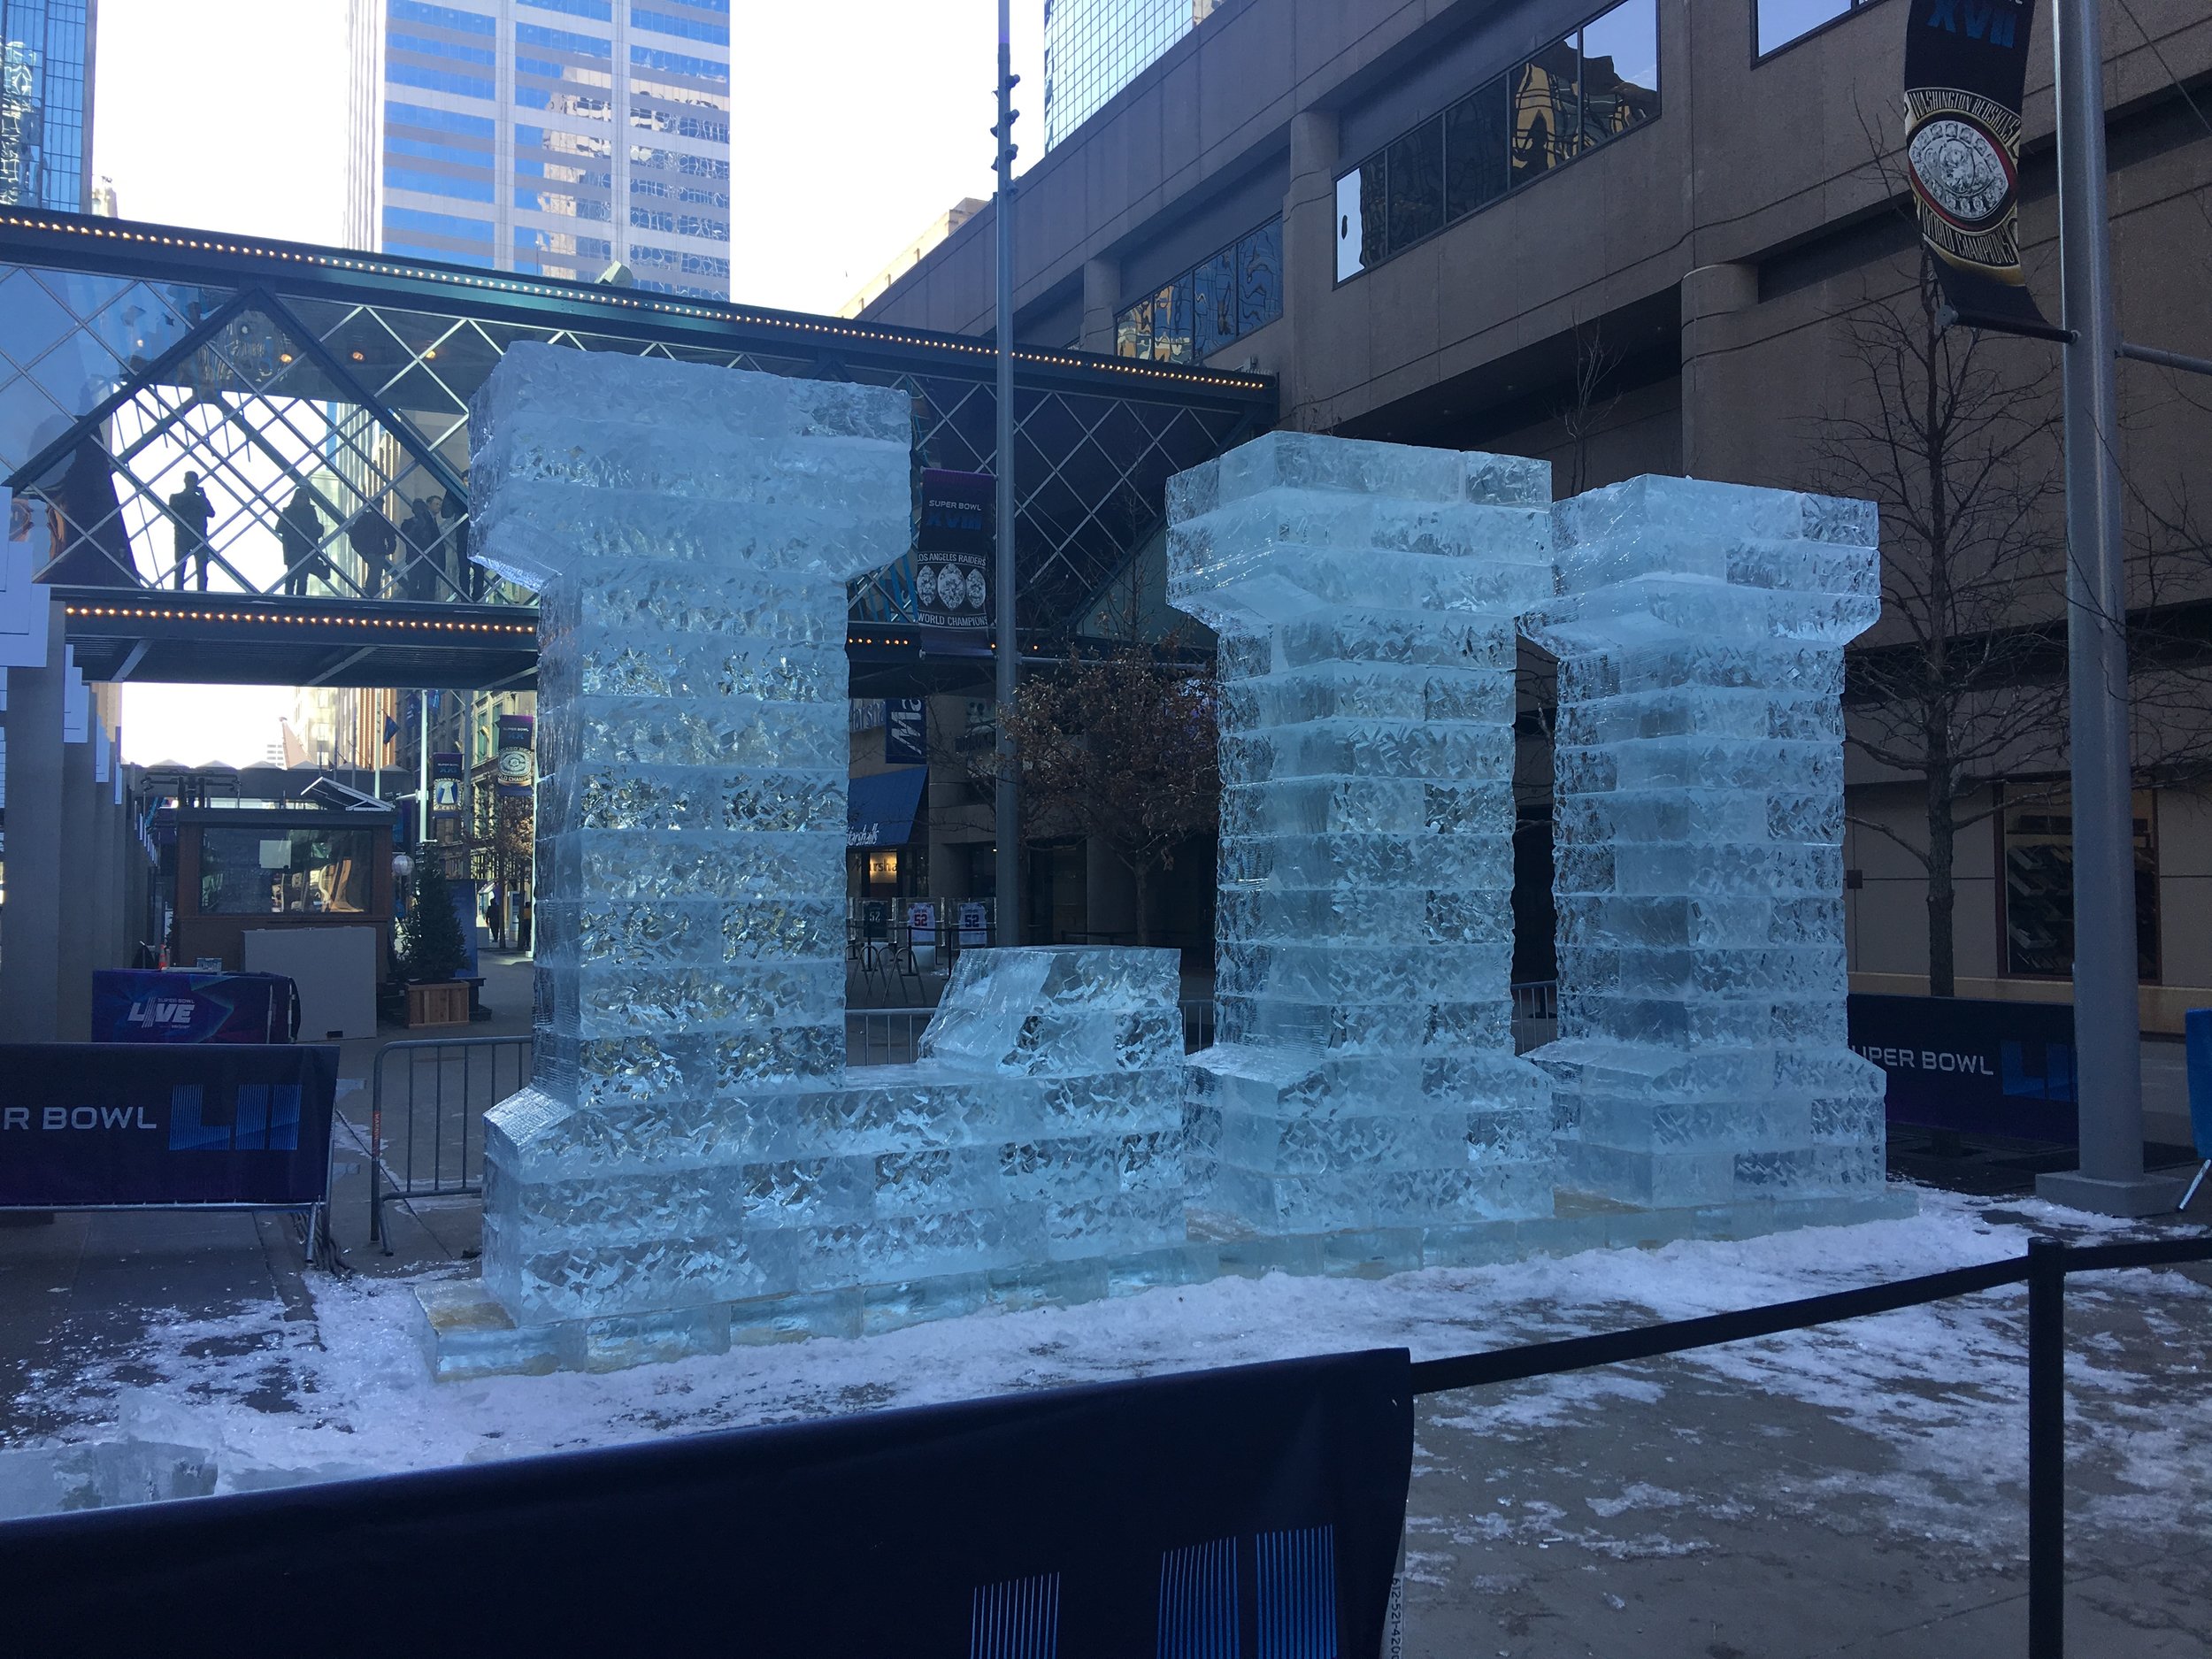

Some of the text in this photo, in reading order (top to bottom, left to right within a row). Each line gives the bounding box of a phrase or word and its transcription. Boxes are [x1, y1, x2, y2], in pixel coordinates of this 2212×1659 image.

[1909, 90, 2021, 142] WASHINGTON REDSKINS
[1955, 222, 2016, 264] CHAMPIONS
[928, 499, 956, 509] SUPER
[929, 553, 956, 562] ANGELES
[958, 554, 987, 566] RAIDERS
[918, 612, 945, 625] WORLD
[914, 913, 928, 926] 52
[964, 914, 979, 928] 52
[127, 998, 195, 1027] LIVE
[1922, 1050, 1994, 1076] BOWL
[42, 1106, 157, 1131] BOWL
[169, 1084, 303, 1150] LII
